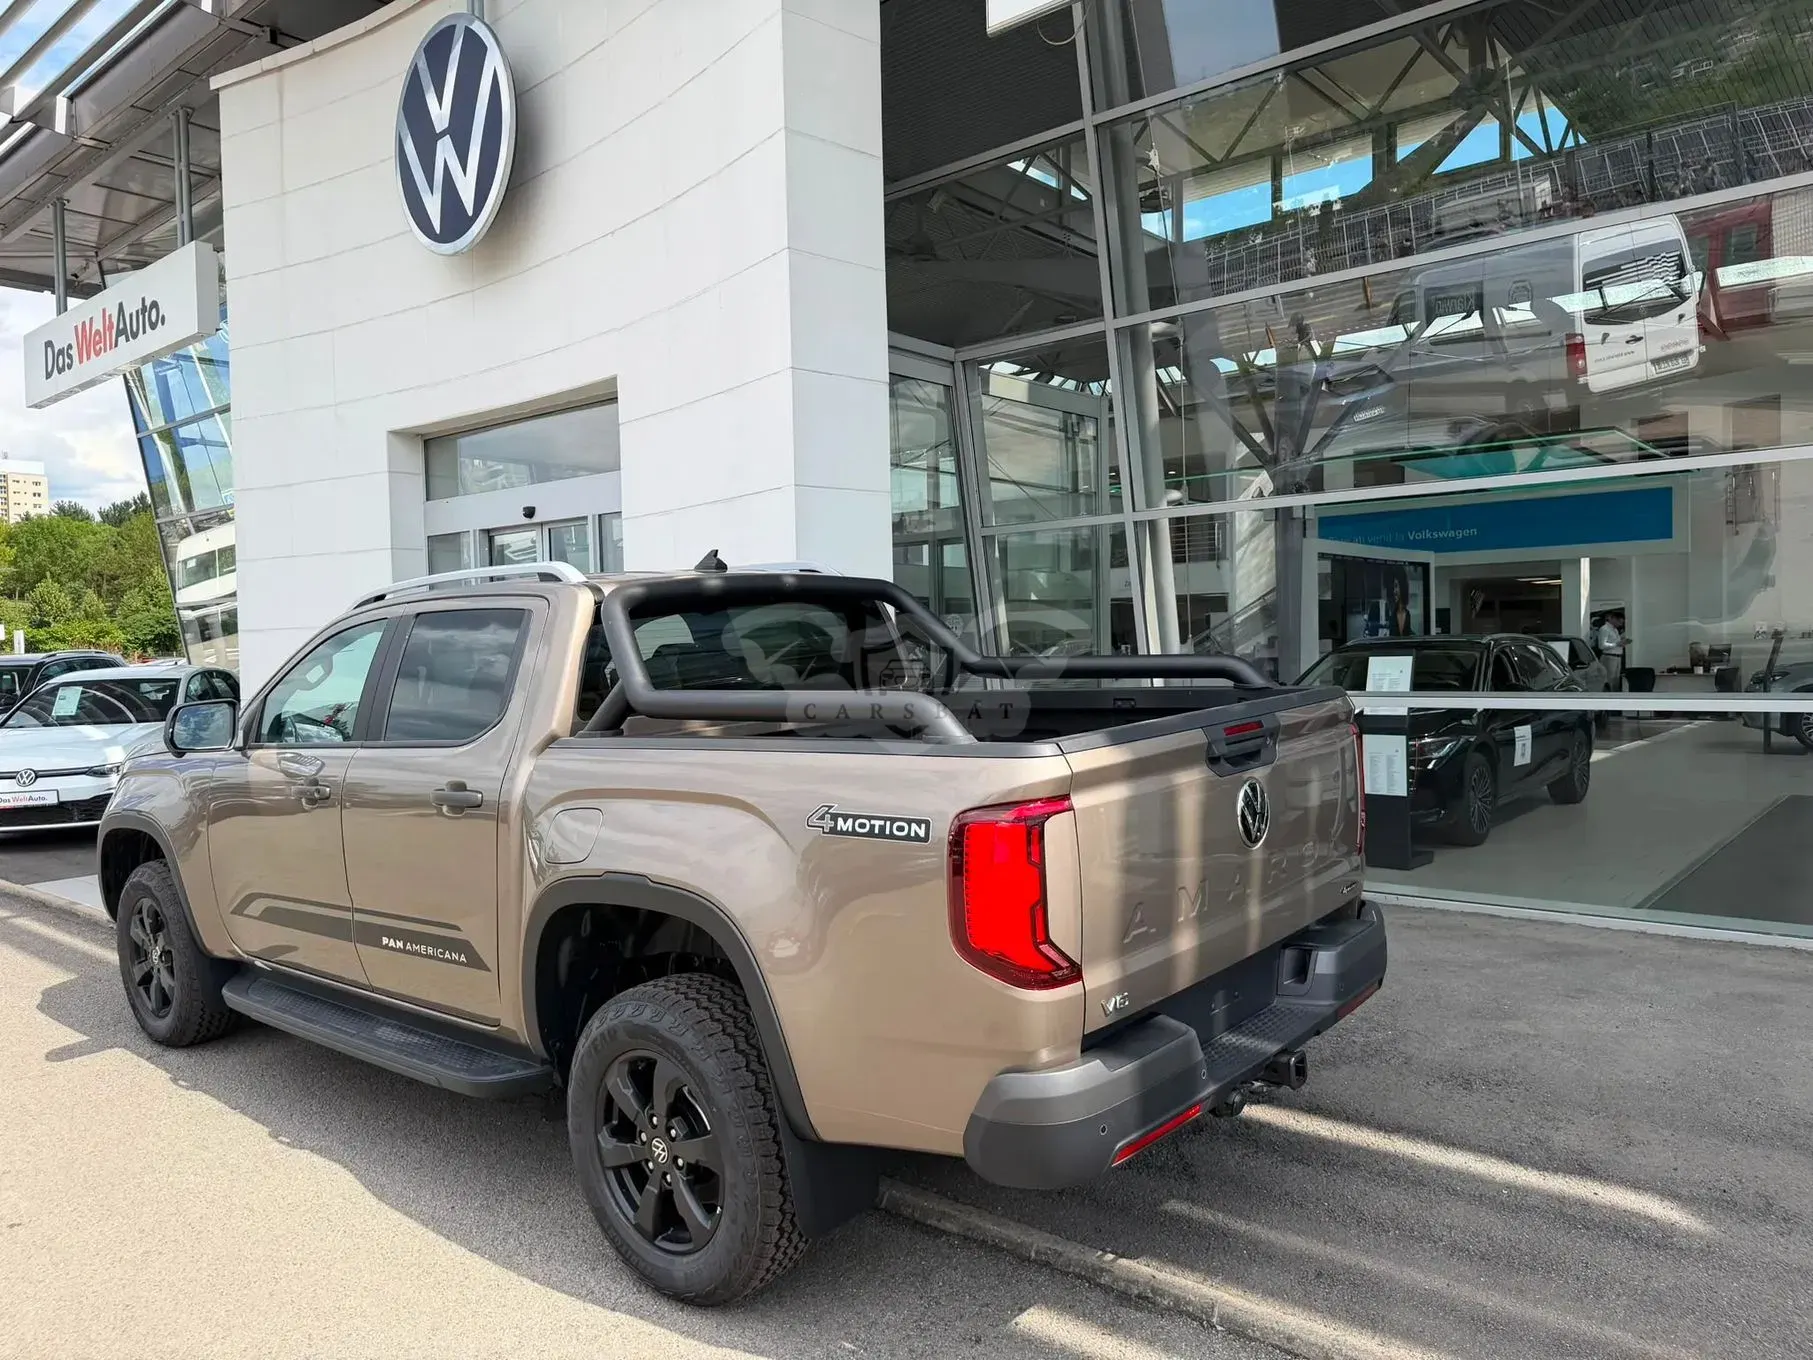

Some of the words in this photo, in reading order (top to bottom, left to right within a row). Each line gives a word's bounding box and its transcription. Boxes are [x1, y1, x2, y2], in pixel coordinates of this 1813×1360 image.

[44, 339, 74, 380] Das
[74, 296, 166, 365] WeltAuto.
[1408, 527, 1478, 541] Volkswagen
[806, 804, 928, 840] 4MOTION
[382, 936, 404, 950] PAN
[405, 942, 467, 963] AMERICANA
[1100, 992, 1130, 1016] V6
